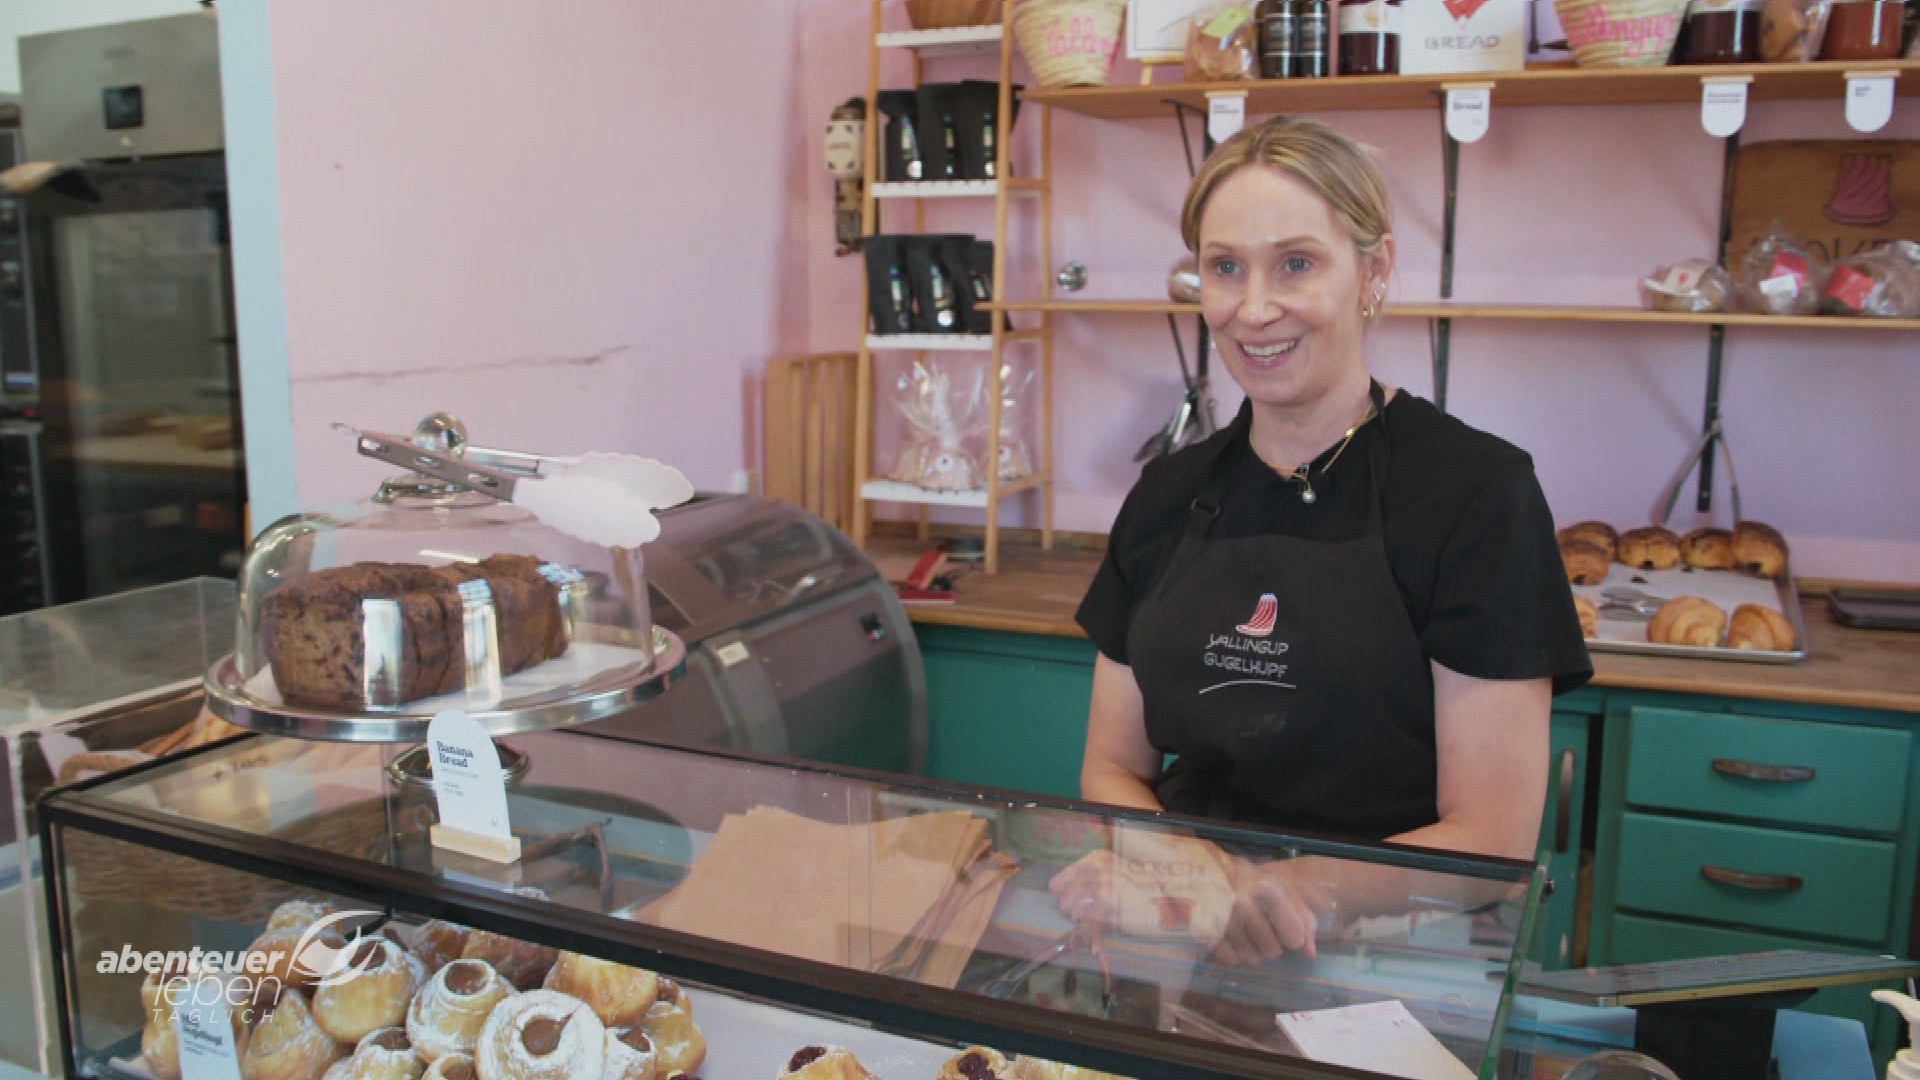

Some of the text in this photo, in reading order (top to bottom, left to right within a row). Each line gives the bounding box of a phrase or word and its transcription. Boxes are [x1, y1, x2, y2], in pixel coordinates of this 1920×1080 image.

[1424, 34, 1501, 51] BREAD
[1205, 633, 1289, 655] YALLINGUP
[1204, 652, 1288, 677] GUGELHUPF
[436, 740, 474, 759] Banana
[439, 752, 469, 768] Bread
